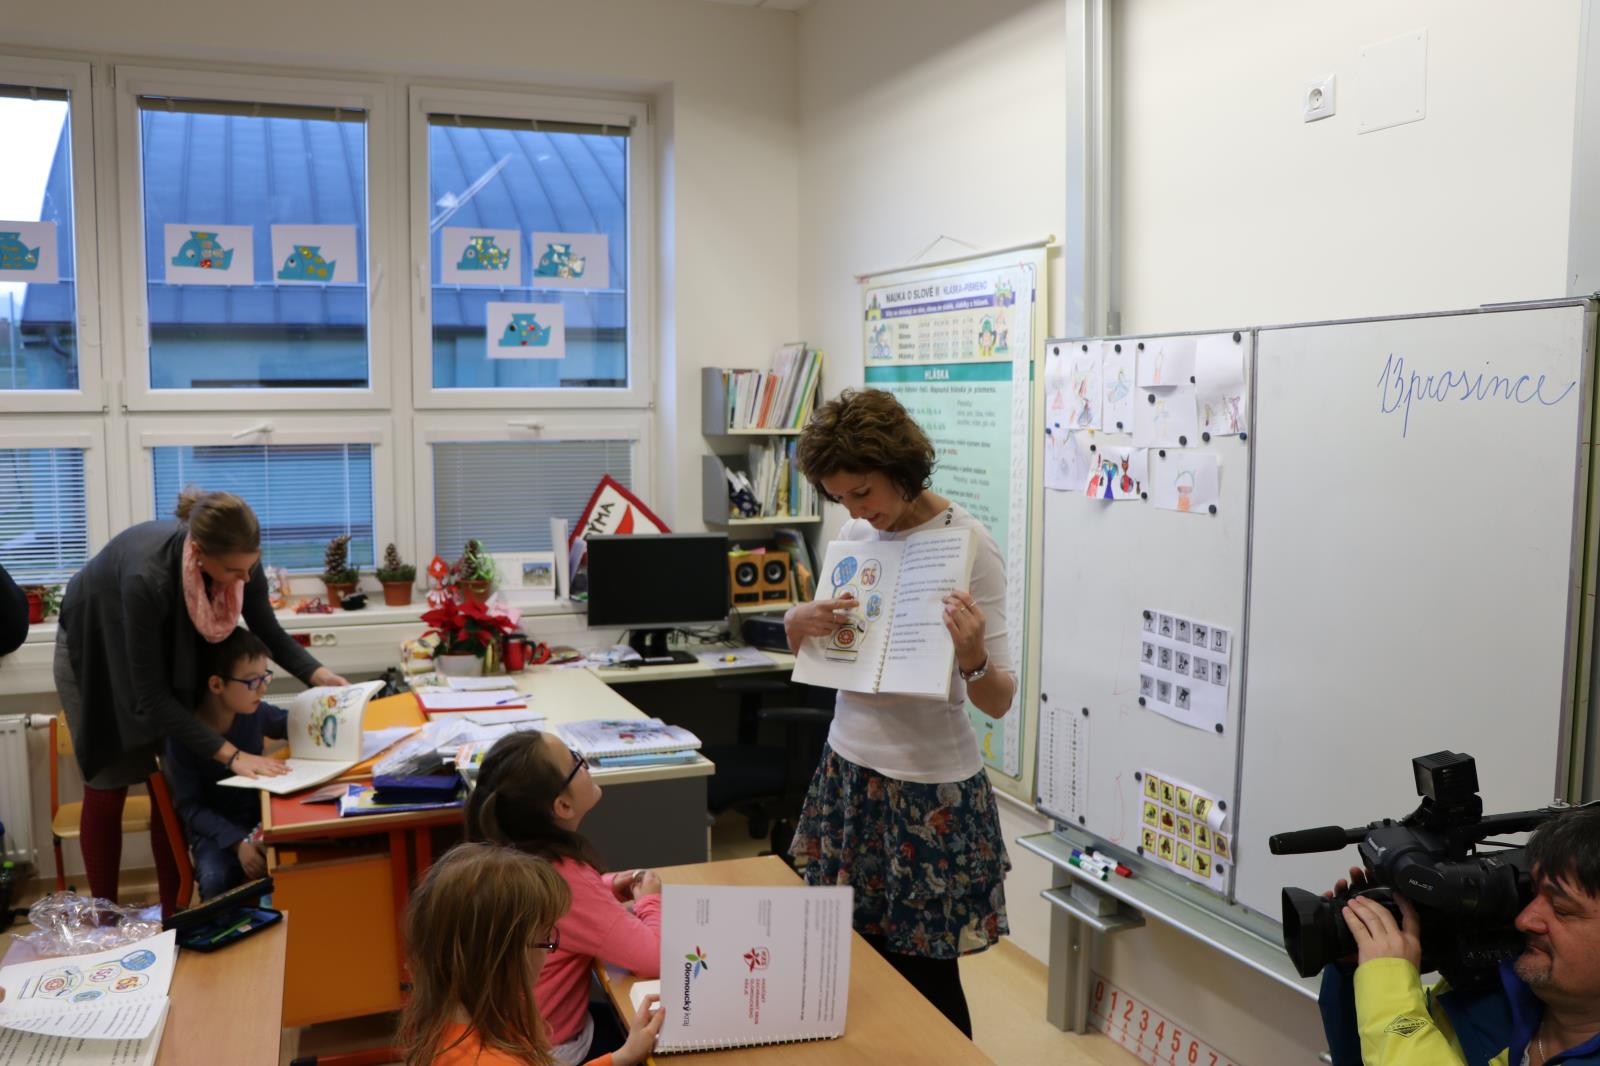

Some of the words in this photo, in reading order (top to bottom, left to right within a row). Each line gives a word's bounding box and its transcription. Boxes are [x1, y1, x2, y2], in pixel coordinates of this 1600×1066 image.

[886, 291, 906, 303] NAUKA
[907, 291, 912, 301] O
[924, 368, 949, 380] HLÁSKA
[682, 962, 692, 1012] Olomoucký
[682, 1012, 691, 1027] kraj
[1095, 981, 1104, 1002] 0
[1111, 991, 1118, 1011] 1
[1123, 1000, 1134, 1022] 2
[1139, 1009, 1149, 1032] 3
[1155, 1021, 1165, 1042] 4
[1171, 1029, 1182, 1053] 5
[1188, 1041, 1198, 1064] 6
